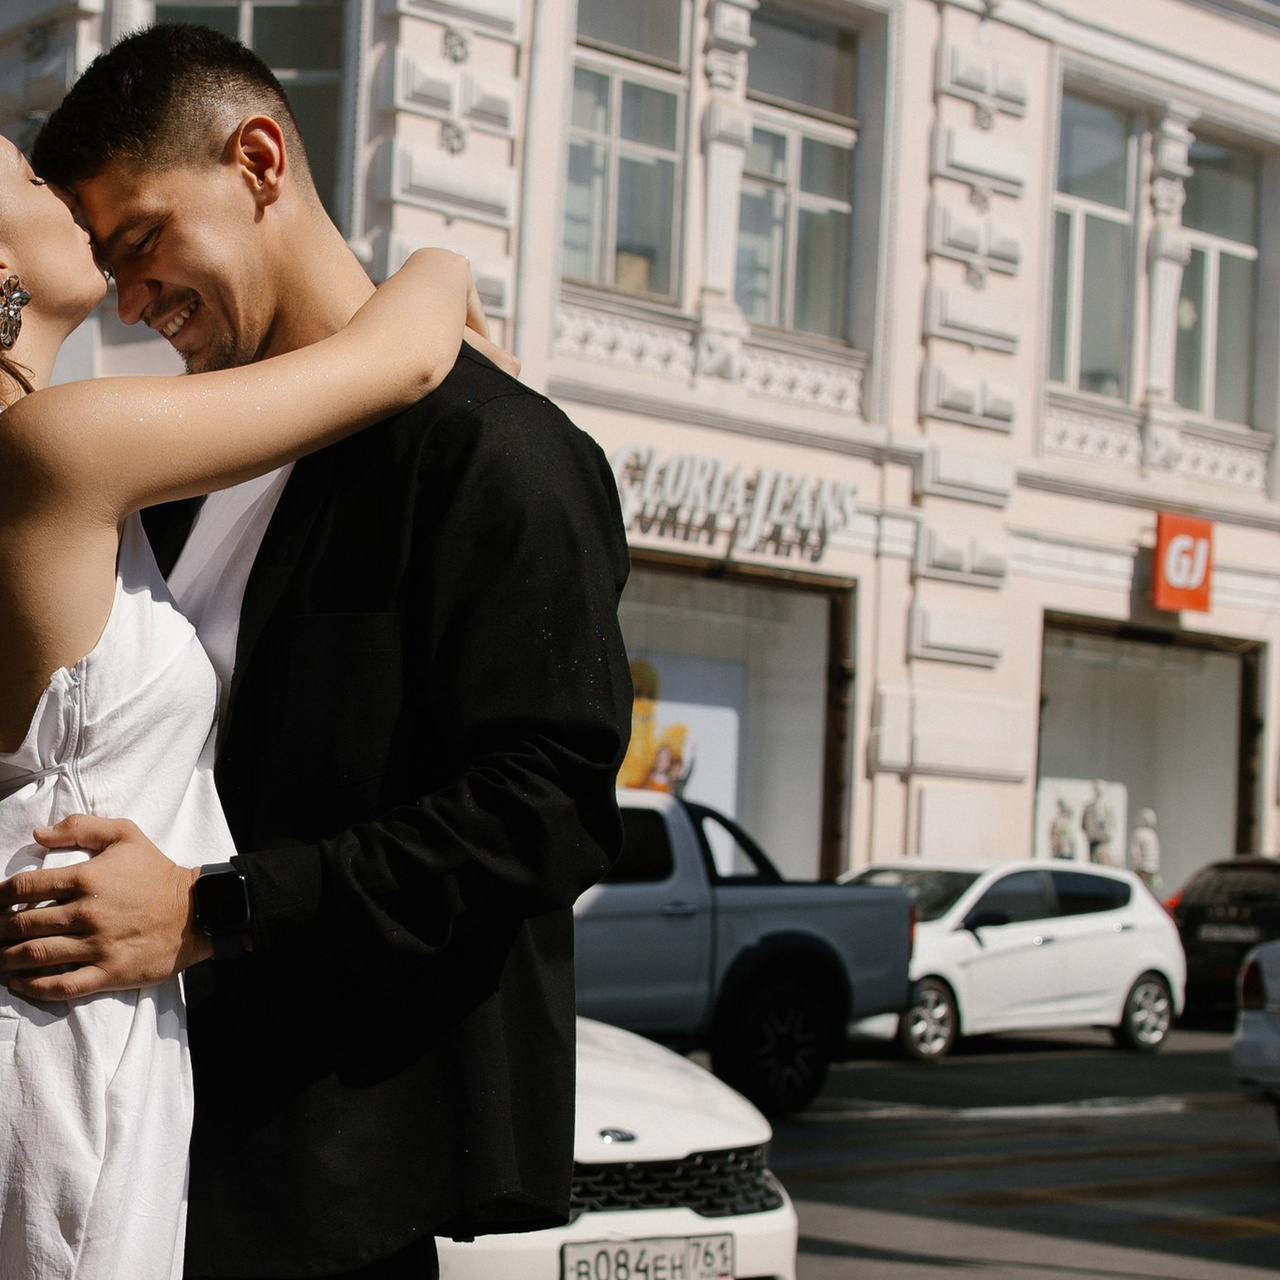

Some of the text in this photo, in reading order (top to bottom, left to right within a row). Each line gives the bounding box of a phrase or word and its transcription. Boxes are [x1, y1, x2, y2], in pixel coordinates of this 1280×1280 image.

[611, 443, 857, 551] GLORIA JEANS
[1164, 533, 1209, 590] GJ
